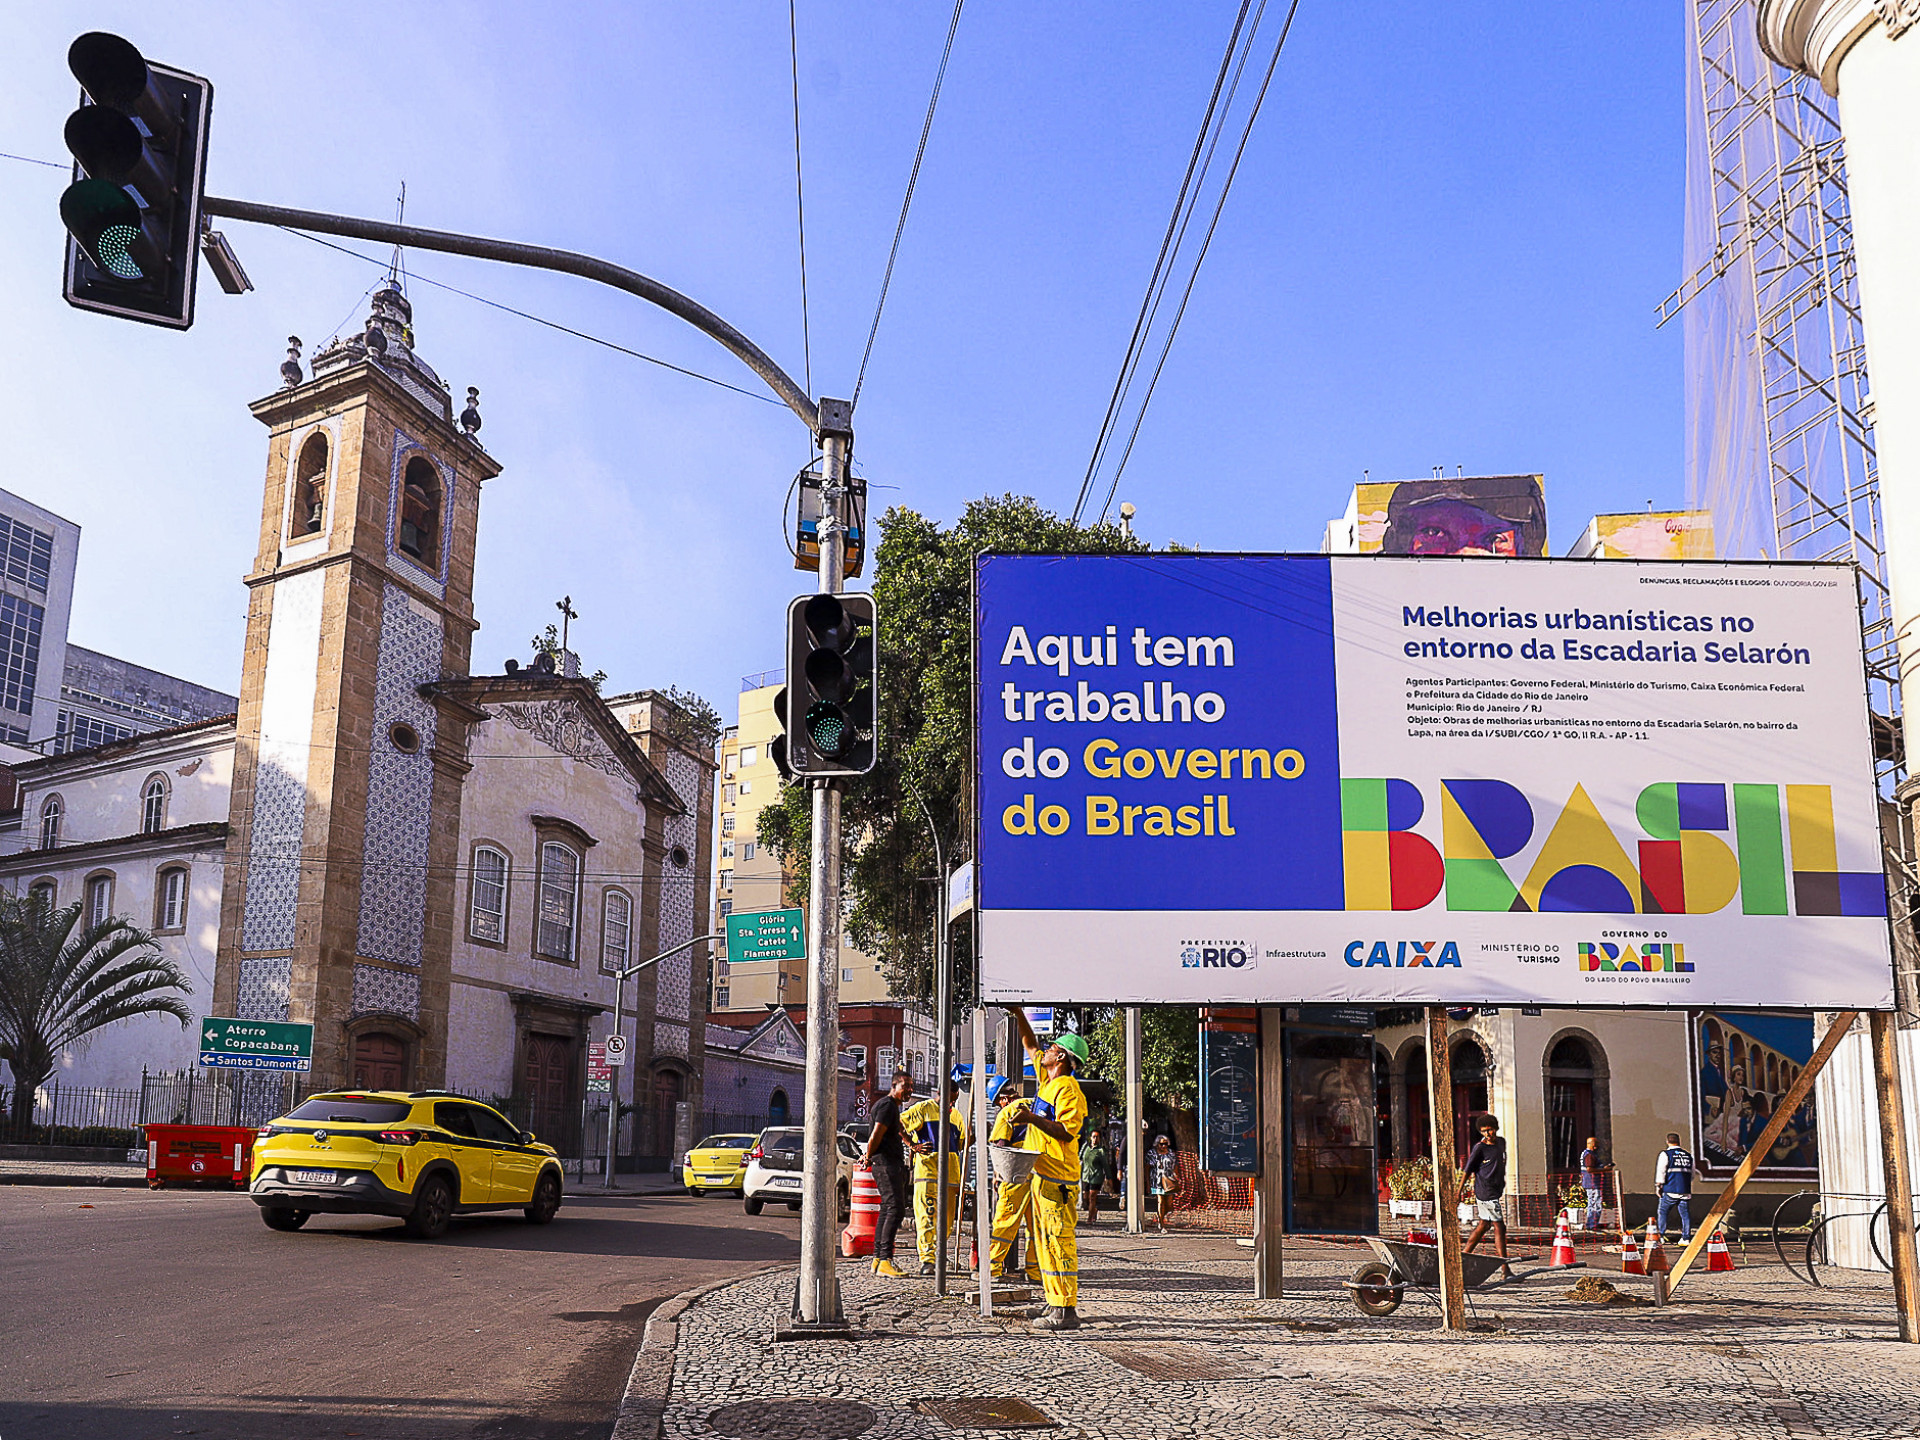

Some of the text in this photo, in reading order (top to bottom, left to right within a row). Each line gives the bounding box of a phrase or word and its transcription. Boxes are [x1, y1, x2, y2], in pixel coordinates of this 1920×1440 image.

[1683, 578, 1733, 586] RECLAMAÇÕES
[1402, 606, 1754, 632] Melhorias urbanísticas no
[1000, 625, 1235, 677] Aqui tem
[1403, 637, 1810, 665] entorno da Escadaria Selarón
[1406, 678, 1443, 687] Agentes
[1445, 678, 1508, 688] Participantes:
[1510, 679, 1549, 687] Governo
[1550, 680, 1588, 689] Federal,
[1590, 681, 1634, 689] Ministério
[1650, 682, 1689, 691] Turismo,
[1691, 682, 1716, 691] Caixa
[1718, 682, 1768, 691] Econômica
[1770, 684, 1805, 692] Federal
[1001, 681, 1226, 722] trabalho
[1414, 690, 1460, 698] Prefeitura
[1462, 691, 1474, 699] da
[1476, 691, 1508, 699] Cidade
[1510, 692, 1522, 700] do
[1525, 692, 1539, 700] Rio
[1555, 692, 1588, 701] Janeiro
[1407, 703, 1454, 713] Município:
[1487, 704, 1520, 712] Janeiro
[1407, 716, 1441, 725] Objeto:
[1486, 717, 1532, 725] melhorias
[1534, 717, 1590, 726] urbanísticas
[1704, 720, 1741, 729] Selarón,
[1408, 729, 1434, 738] Lapa,
[1564, 731, 1580, 740] GO,
[1002, 736, 1306, 780] do Governo
[1002, 794, 1236, 837] do Brasil
[1340, 778, 1889, 918] BRASIL
[759, 915, 785, 924] Glória
[739, 926, 786, 937] Sta. Teresa
[744, 949, 787, 958] Flamengo
[1344, 940, 1462, 968] CAIXA
[1481, 944, 1540, 952] MINISTÉRIO
[1203, 948, 1247, 968] RIO
[1578, 942, 1695, 972] BRASIL
[226, 1025, 266, 1036] Aterro
[225, 1038, 299, 1051] Copacabana
[217, 1056, 296, 1068] Santos Dumont
